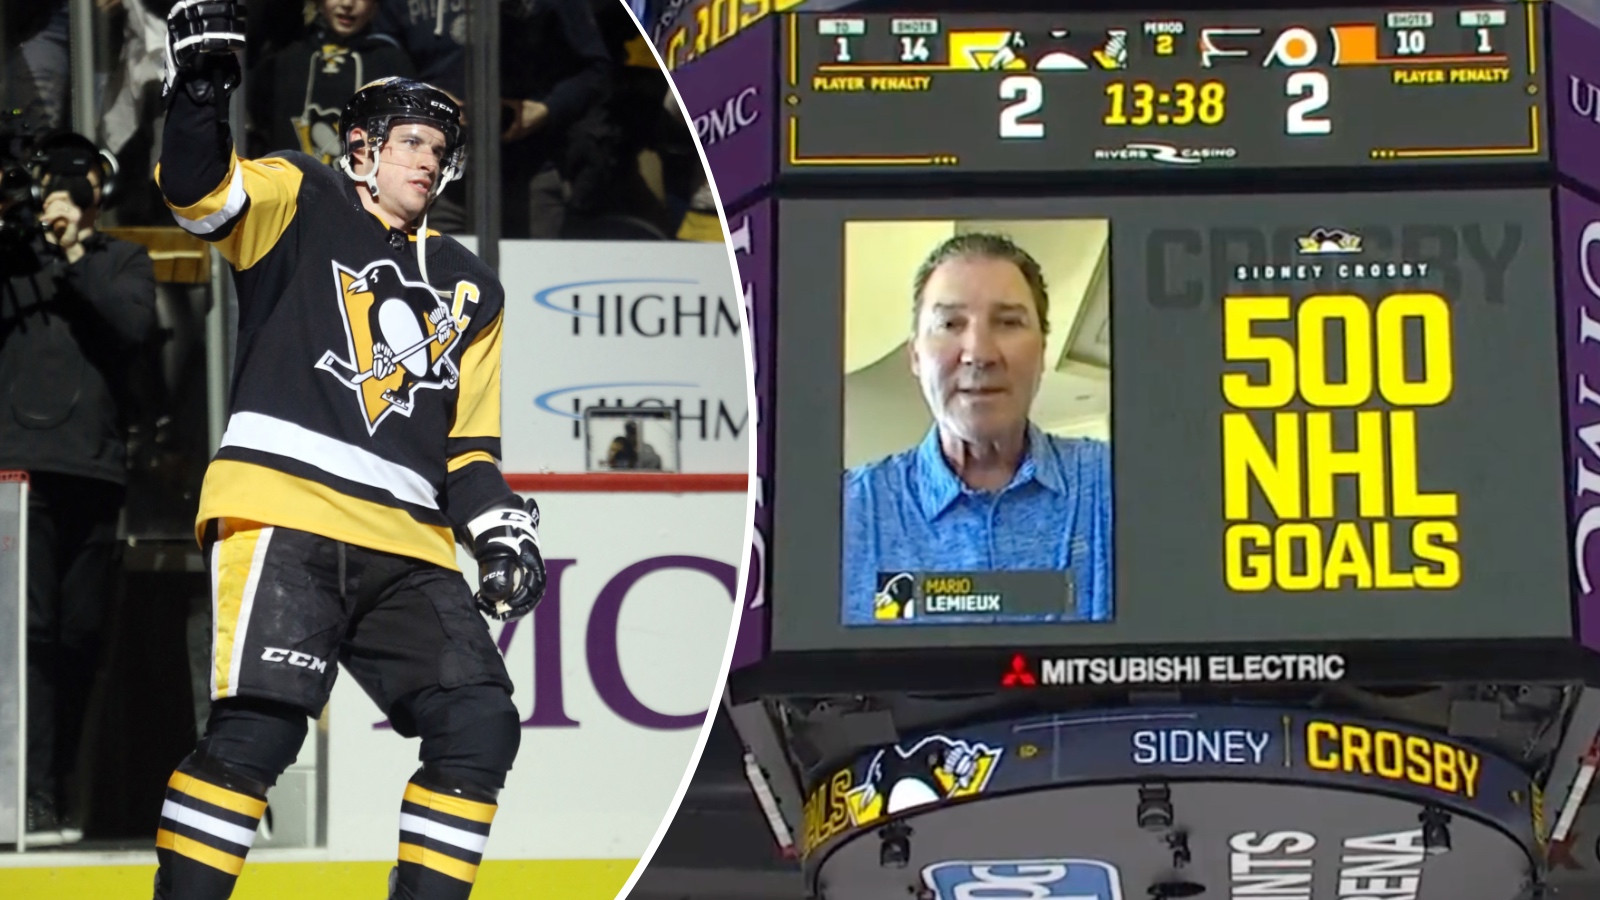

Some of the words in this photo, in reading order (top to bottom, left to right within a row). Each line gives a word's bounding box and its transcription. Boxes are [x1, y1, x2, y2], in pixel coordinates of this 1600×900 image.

[1144, 21, 1184, 34] PERIOD
[836, 37, 851, 61] 1
[1157, 35, 1173, 54] 2
[1396, 30, 1425, 54] 10
[1477, 28, 1492, 53] 1
[813, 76, 865, 91] PLAYER
[870, 75, 931, 91] PENALTY
[1393, 69, 1444, 84] PLAYER
[1449, 67, 1510, 82] PENALTY
[430, 100, 454, 114] CCM
[999, 75, 1045, 138] 2
[1104, 81, 1225, 125] 13:38
[1286, 72, 1331, 134] 2
[1094, 148, 1149, 159] RIVERS
[1181, 147, 1236, 158] CASINO
[1235, 265, 1323, 280] SIDNEY
[1338, 262, 1429, 278] CROSBY
[454, 280, 480, 331] C
[1222, 293, 1453, 408] 500
[572, 397, 749, 442] HHM
[1222, 410, 1457, 520] NHL
[1224, 521, 1460, 591] GOALS
[482, 570, 505, 583] CCM
[925, 579, 971, 593] MARIO
[926, 595, 1000, 612] LEMIEUX
[261, 646, 327, 674] CCM
[1041, 658, 1201, 685] MITSUBISHI
[1208, 654, 1345, 682] ELECTRIC
[1133, 729, 1270, 764] SIDNEY
[1306, 721, 1480, 798] CROSBY
